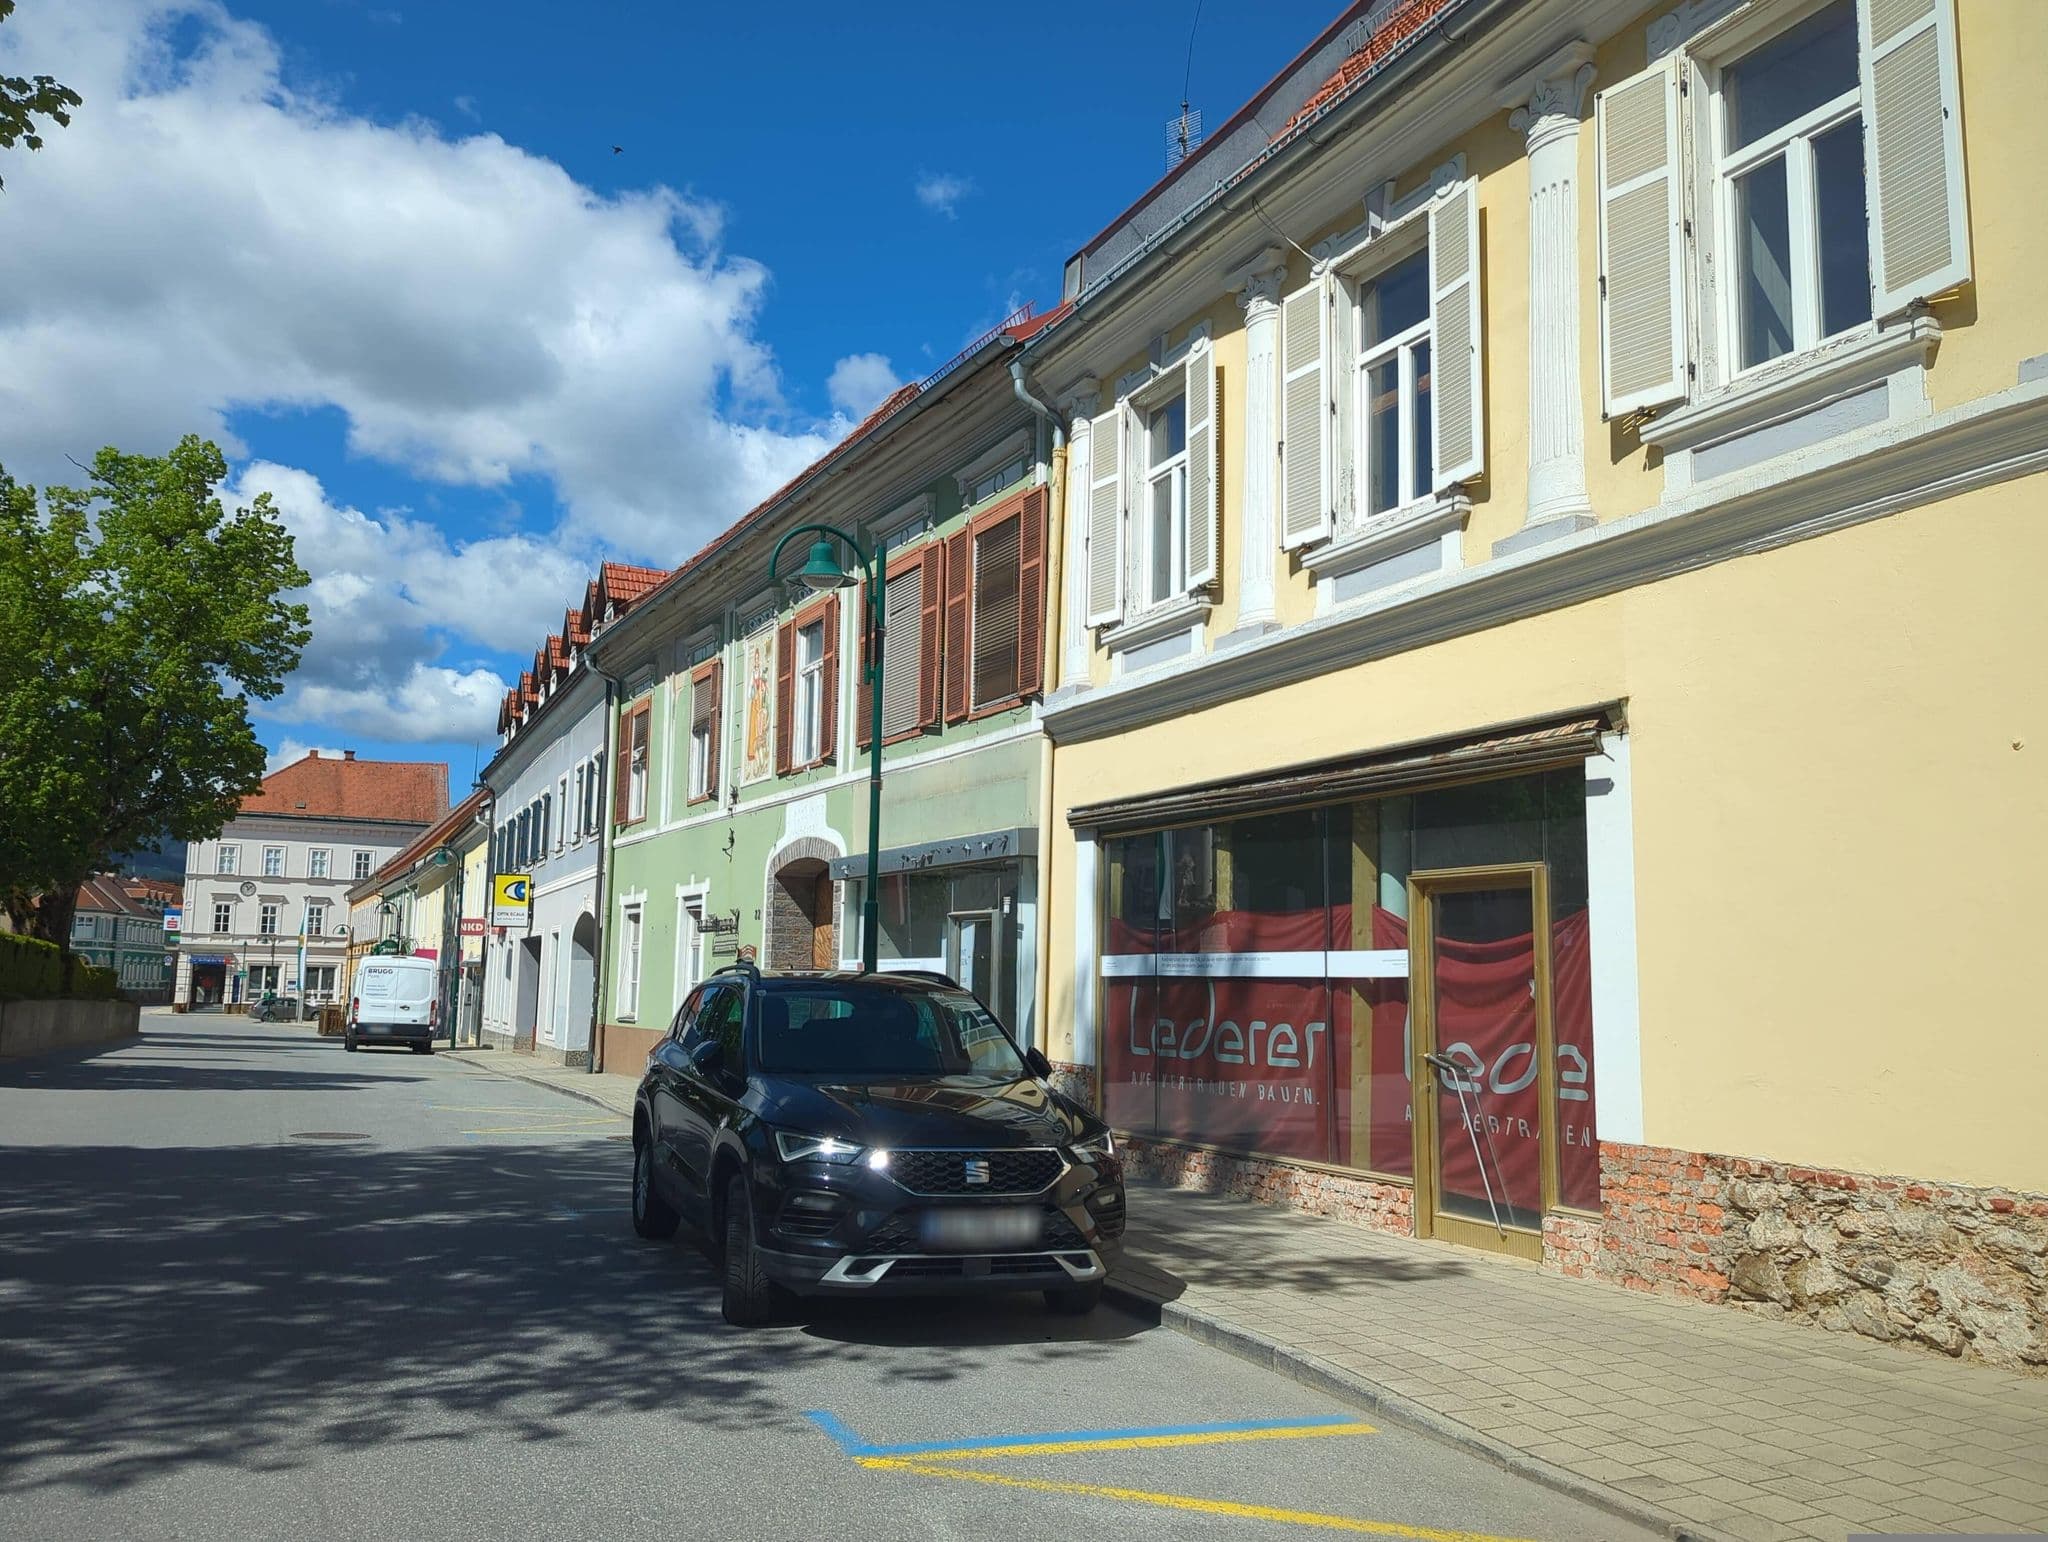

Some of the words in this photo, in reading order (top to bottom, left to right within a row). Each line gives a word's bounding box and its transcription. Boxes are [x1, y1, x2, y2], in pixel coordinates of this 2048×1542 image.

[461, 922, 484, 931] NKD
[1130, 977, 1325, 1070] Lederer
[1131, 1071, 1151, 1086] AUF
[1161, 1072, 1247, 1099] VERTRAUEN
[1257, 1084, 1321, 1105] BAUEN.
